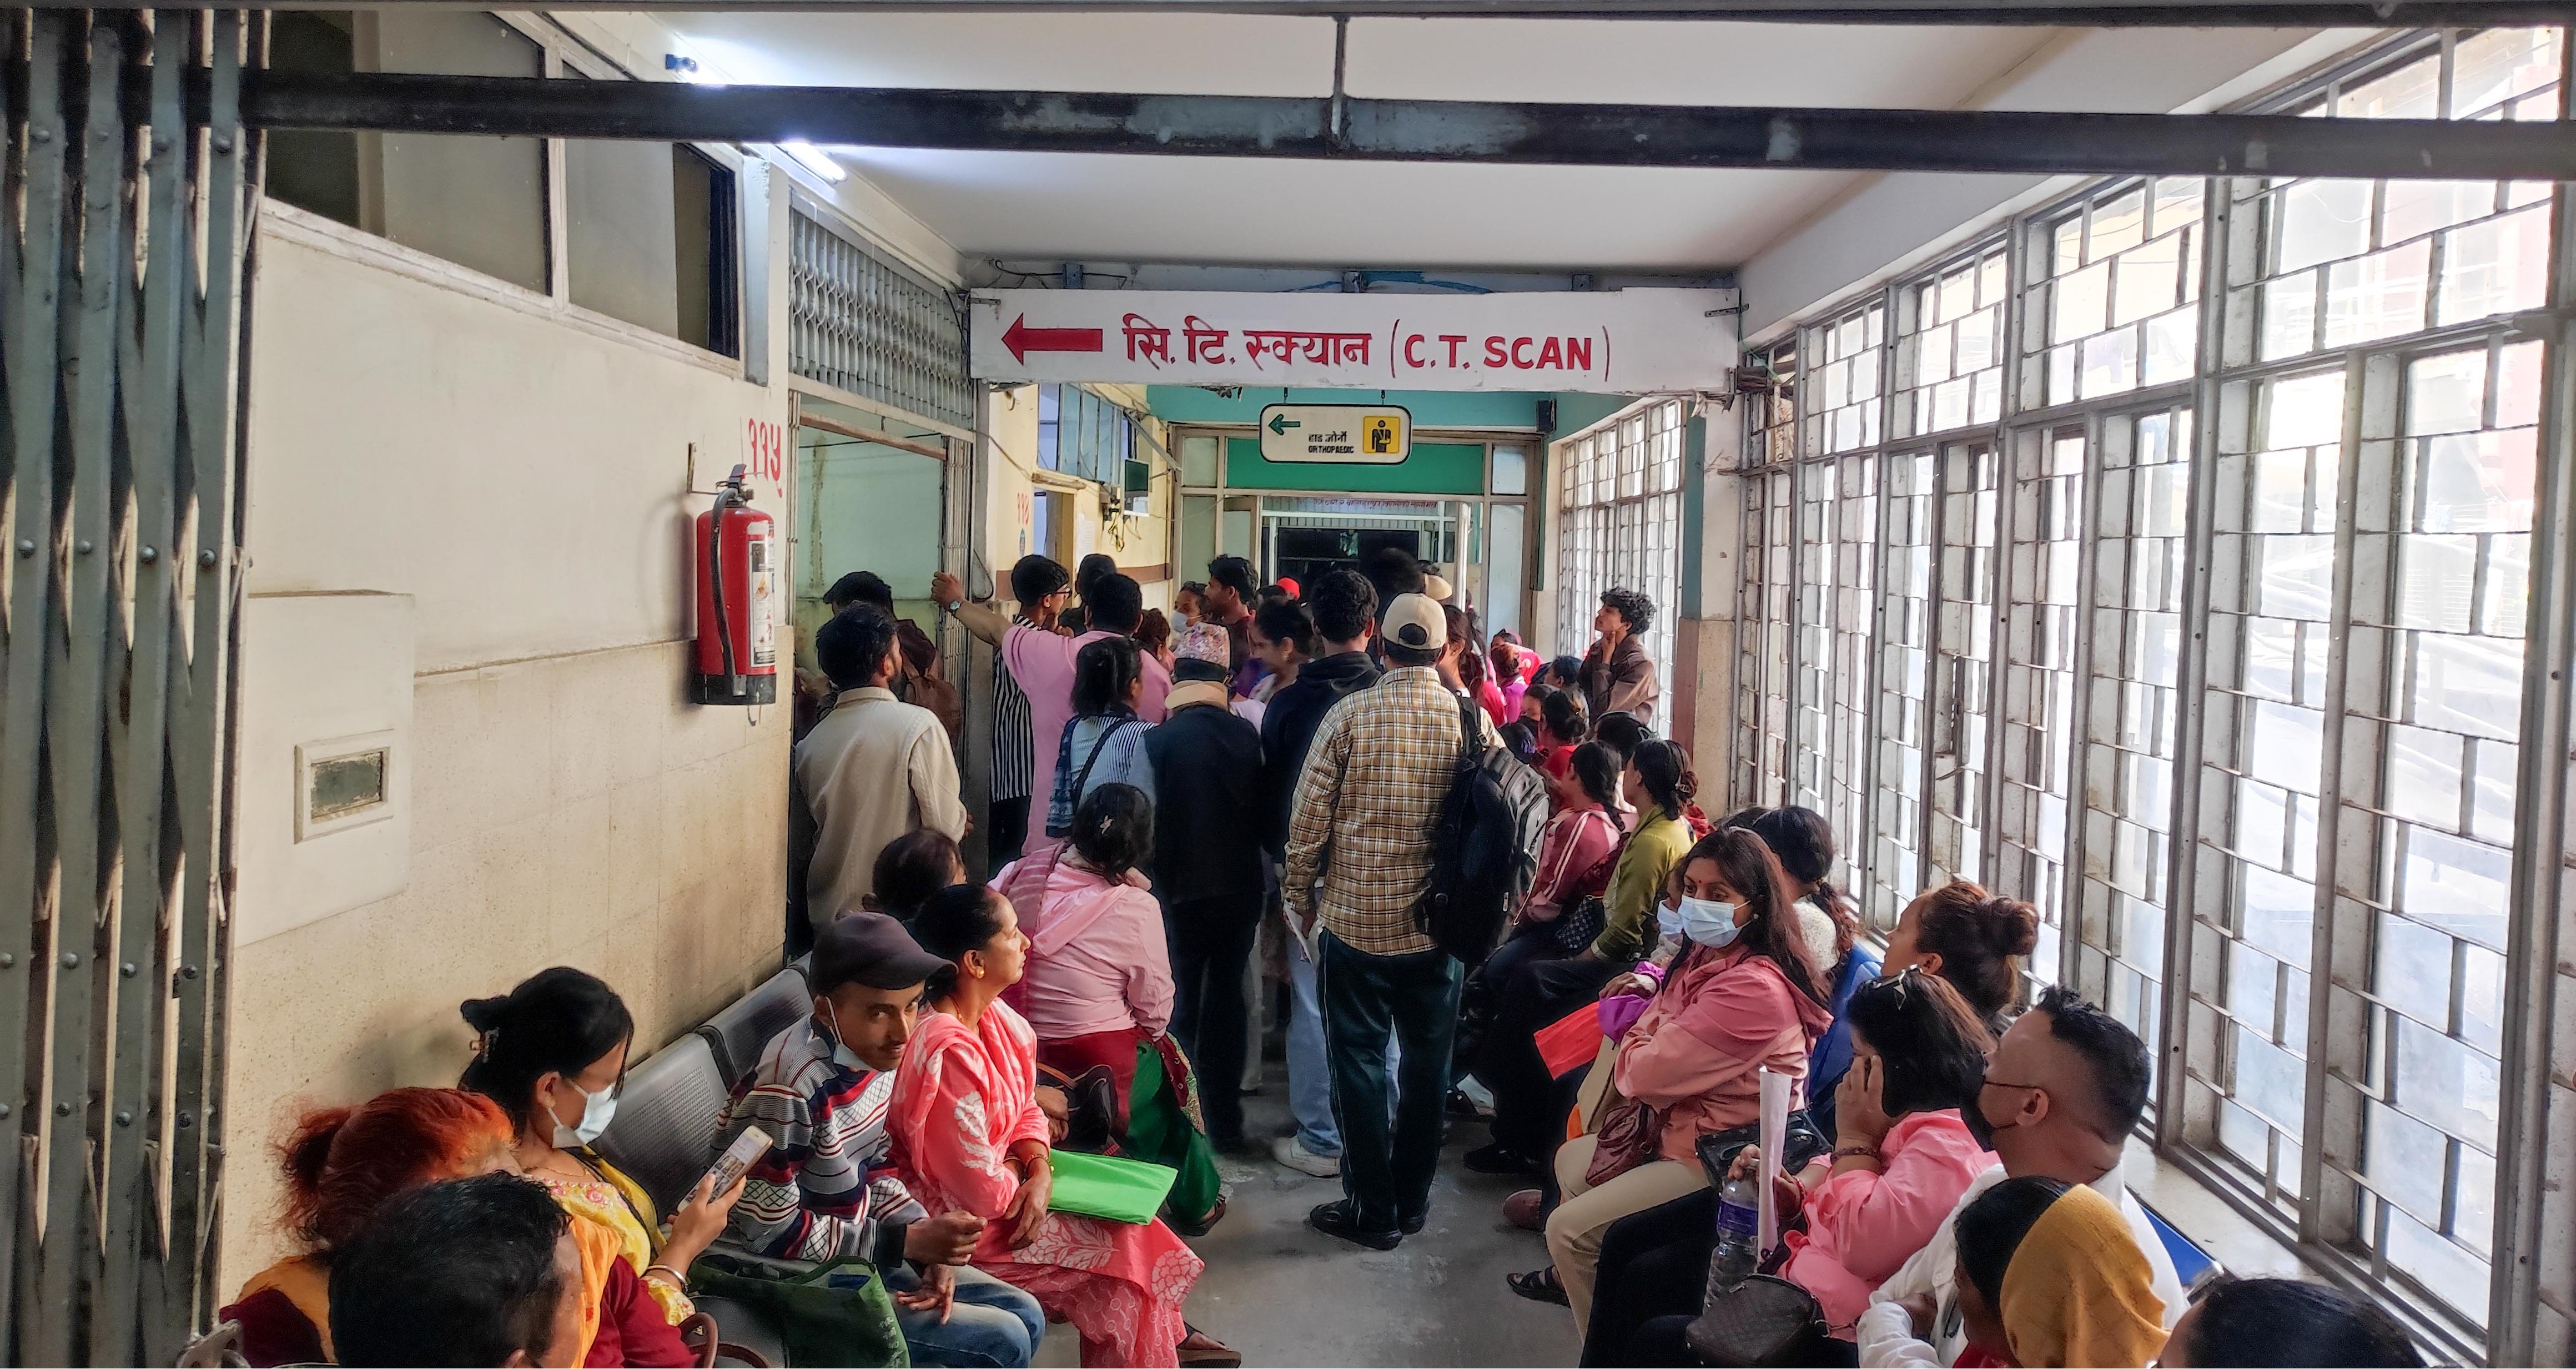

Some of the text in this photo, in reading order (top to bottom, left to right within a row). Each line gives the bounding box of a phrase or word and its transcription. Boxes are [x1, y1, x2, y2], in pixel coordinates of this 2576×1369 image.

[1122, 313, 1609, 382] सि. टि. स्क्यान (C.T. SCAN)
[1308, 445, 1355, 454] ORTHOPAEDIC
